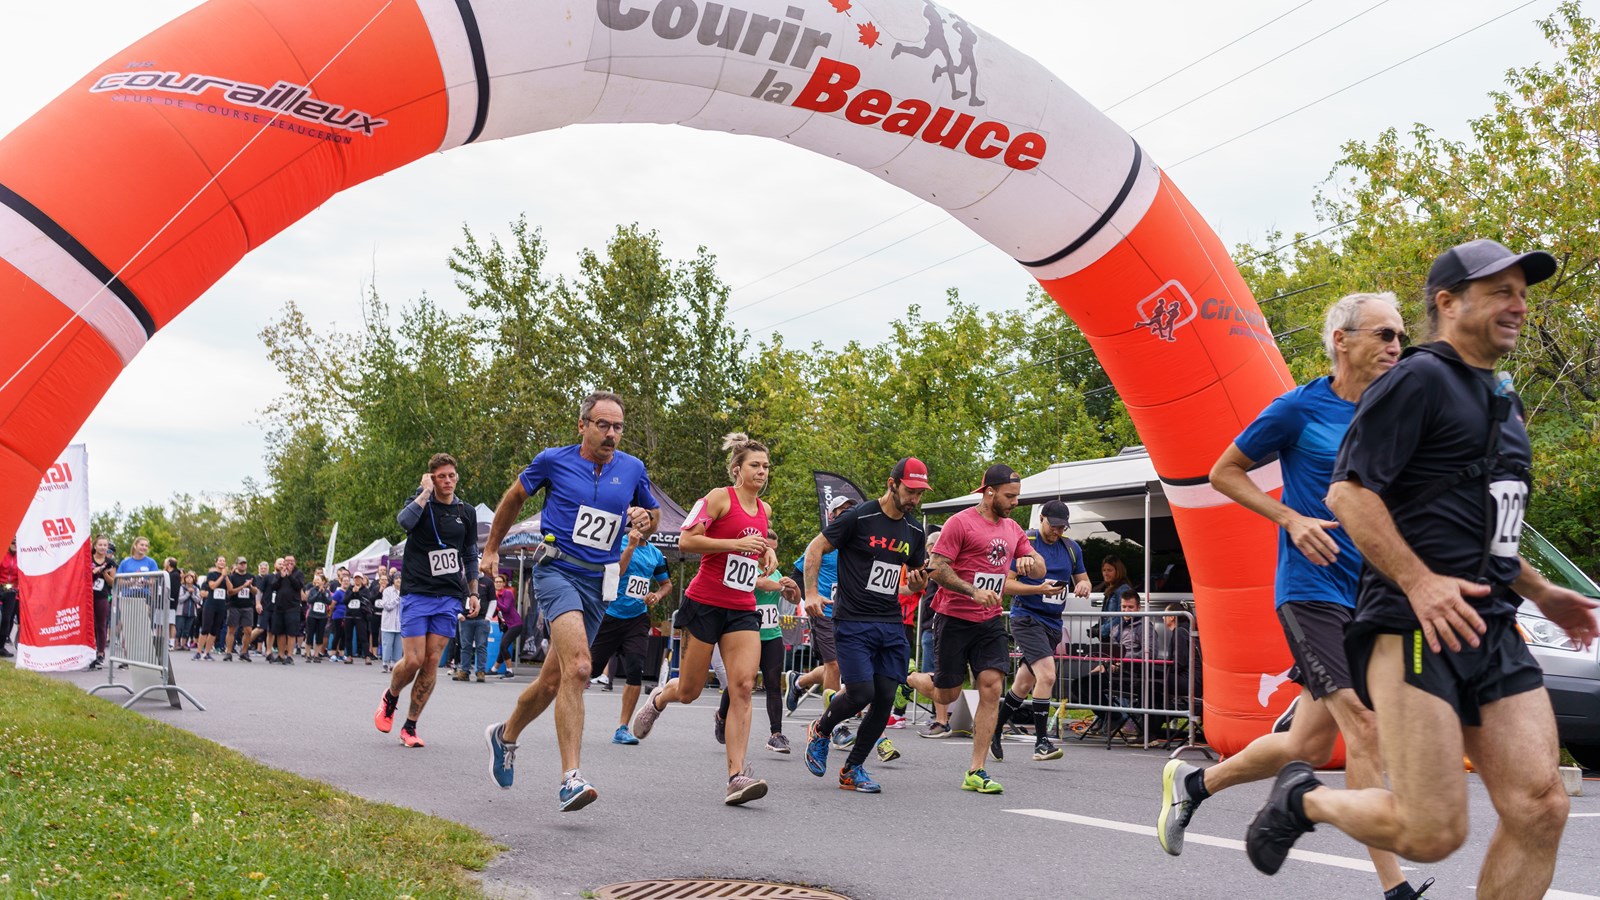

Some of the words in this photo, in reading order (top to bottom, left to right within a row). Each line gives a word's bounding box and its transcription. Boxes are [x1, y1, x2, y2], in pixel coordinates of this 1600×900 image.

[111, 94, 153, 103] CLUB
[164, 98, 184, 108] DE
[195, 102, 259, 124] COURSE
[269, 117, 352, 145] BEAUCERON
[750, 68, 793, 104] la
[791, 57, 1047, 171] Beauce
[577, 512, 617, 544] 221
[432, 552, 457, 571] 203
[727, 559, 756, 587] 202
[628, 579, 649, 596] 205
[871, 566, 899, 589] 200
